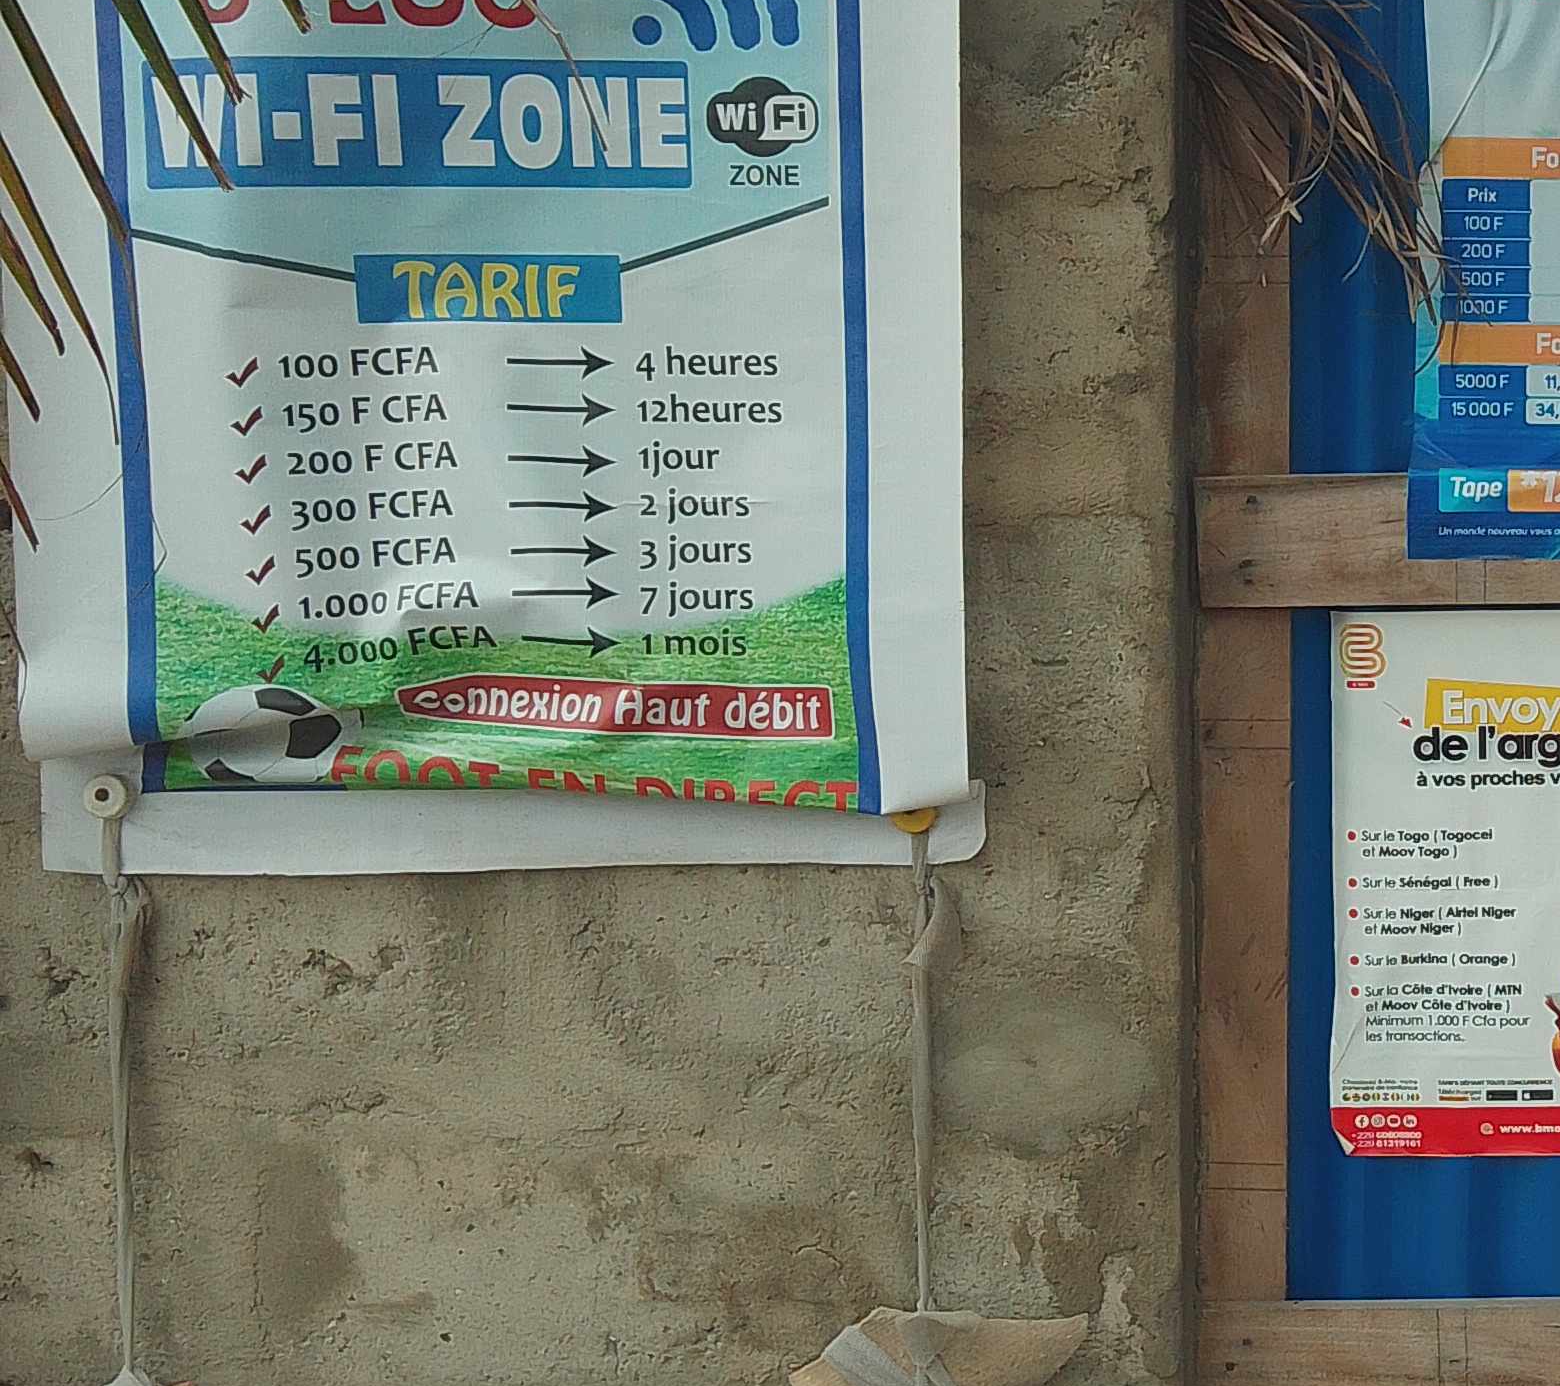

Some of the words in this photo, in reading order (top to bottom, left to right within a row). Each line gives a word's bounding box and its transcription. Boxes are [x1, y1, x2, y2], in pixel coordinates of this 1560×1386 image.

[152, 74, 404, 169] WI-FI
[437, 74, 688, 169] ZONE
[730, 165, 800, 186] ZONE
[1467, 187, 1497, 203] Prix
[1464, 216, 1491, 231] 100
[1494, 216, 1504, 231] F
[1461, 243, 1493, 259] 200
[1496, 244, 1506, 259] F
[392, 260, 580, 319] TARIF
[1461, 271, 1493, 287] 500
[1496, 271, 1506, 287] F
[1459, 299, 1495, 315] 1000
[1498, 300, 1509, 315] F
[278, 354, 339, 379] 100
[350, 346, 439, 377] FCFA
[636, 352, 655, 381] 4
[665, 345, 778, 376] heures
[1455, 374, 1497, 389] 5000
[1500, 374, 1511, 389] F
[282, 402, 340, 434] 150
[351, 396, 371, 425] F
[383, 393, 448, 423] CFA
[636, 394, 783, 423] 12heures
[286, 450, 352, 475] 200
[364, 444, 384, 472] F
[394, 441, 459, 470] CFA
[638, 440, 720, 478] 1jour
[1450, 476, 1503, 503] Tape
[291, 499, 357, 531] 300
[367, 489, 454, 520] FCFA
[640, 494, 657, 517] 2
[667, 487, 751, 525] jours
[294, 546, 360, 579] 500
[371, 537, 457, 567] FCFA
[639, 540, 658, 570] 3
[667, 534, 753, 571] jours
[297, 591, 388, 620] 1.000
[396, 581, 480, 611] FCFA
[639, 586, 658, 615] 7
[667, 581, 754, 617] jours
[303, 637, 398, 674] 4.000
[407, 625, 498, 655] FCFA
[641, 633, 653, 655] 1
[664, 627, 748, 657] mois
[614, 687, 712, 729] Haut
[723, 691, 822, 731] débit
[1412, 726, 1469, 762] de
[1416, 771, 1428, 786] à
[1432, 772, 1466, 786] vos
[1471, 770, 1545, 789] proches
[1398, 830, 1430, 844] Togo
[1441, 828, 1493, 843] Togocel
[1399, 875, 1452, 891] Sénégal
[1463, 876, 1491, 888] Free
[1401, 952, 1448, 965] Burkina
[1402, 983, 1433, 996] Côte
[1365, 1014, 1424, 1027] Minimum
[1428, 1014, 1460, 1027] 1.000
[1463, 1015, 1470, 1027] F
[1472, 1015, 1497, 1027] Cfa
[1499, 1017, 1531, 1030] pour
[1365, 1030, 1382, 1043] les
[1386, 1030, 1466, 1043] transactions.
